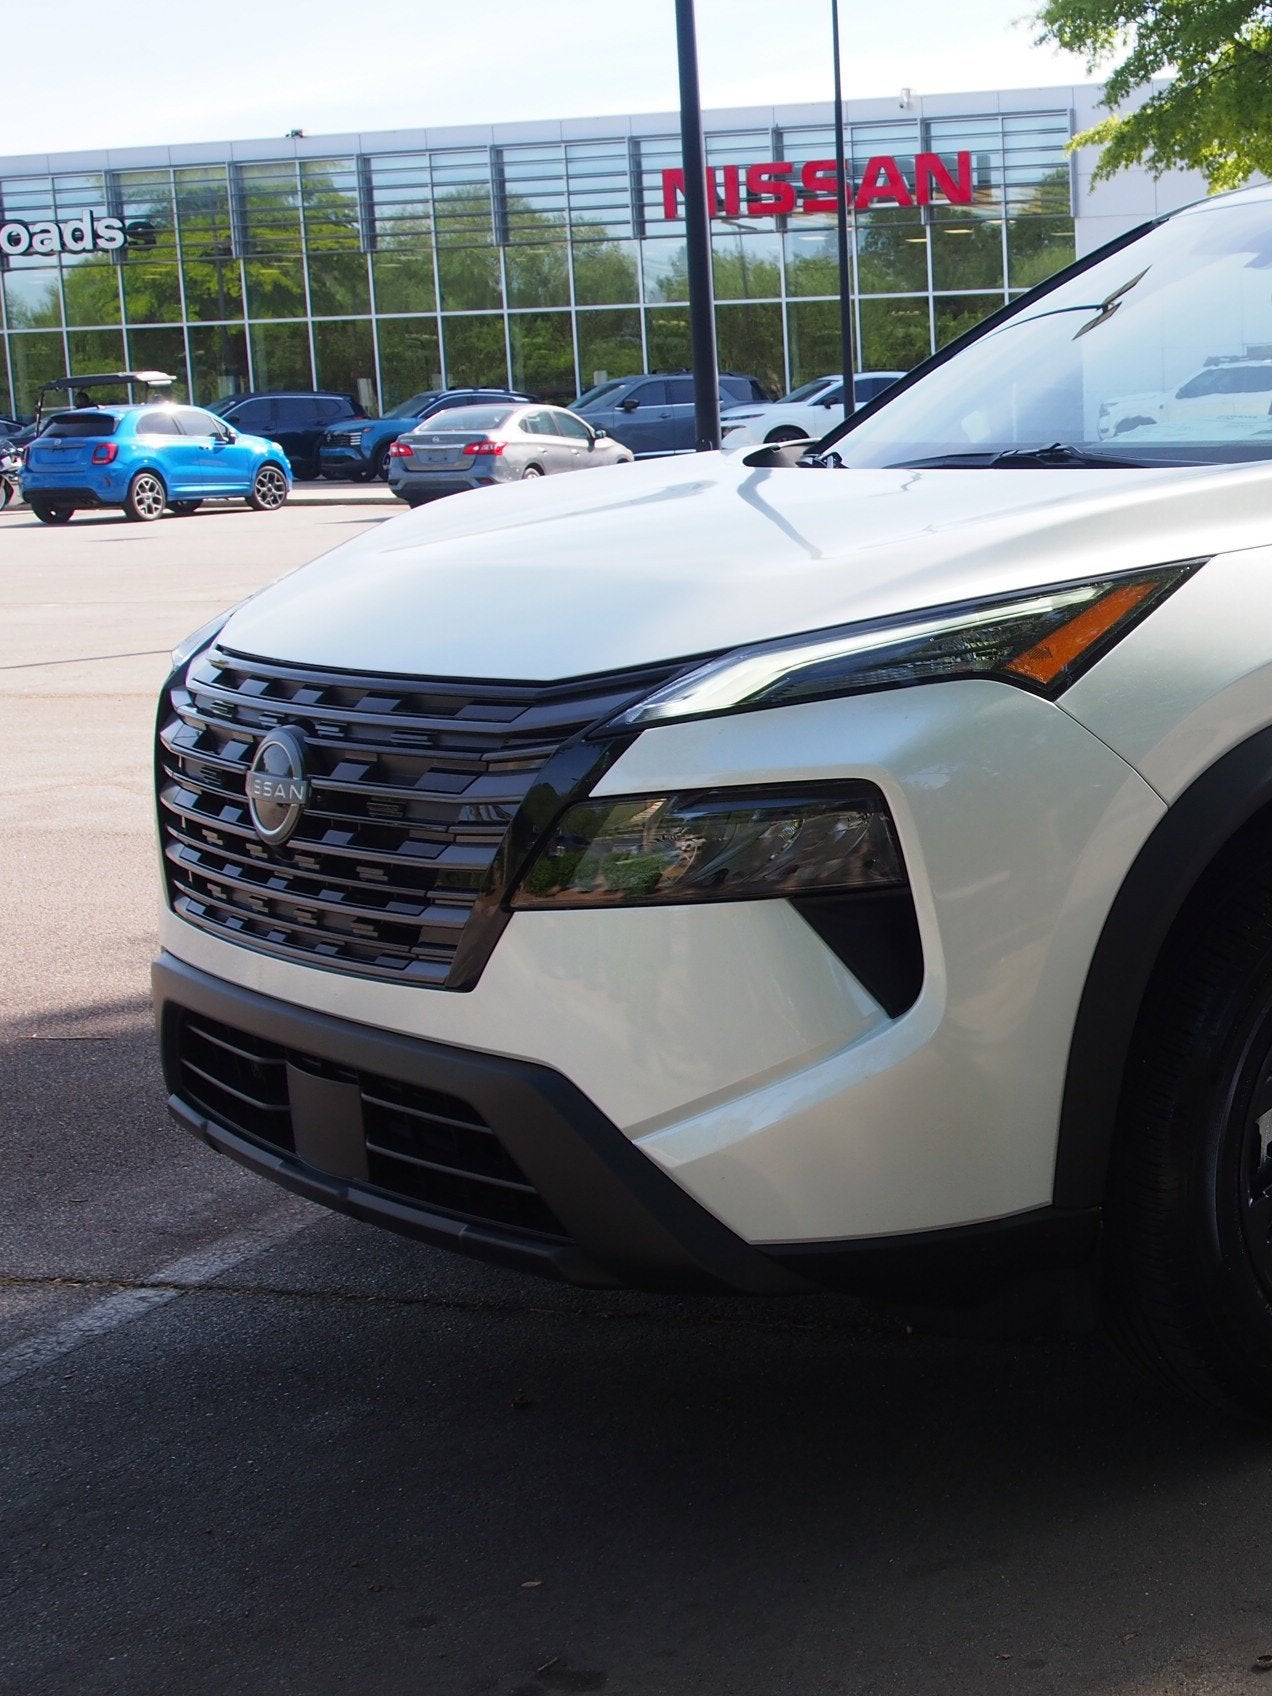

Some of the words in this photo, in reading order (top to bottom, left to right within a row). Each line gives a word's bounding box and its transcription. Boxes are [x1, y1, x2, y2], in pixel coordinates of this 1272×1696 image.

[662, 151, 972, 219] NISSAN
[0, 209, 126, 255] oads
[249, 779, 304, 800] SSAN
